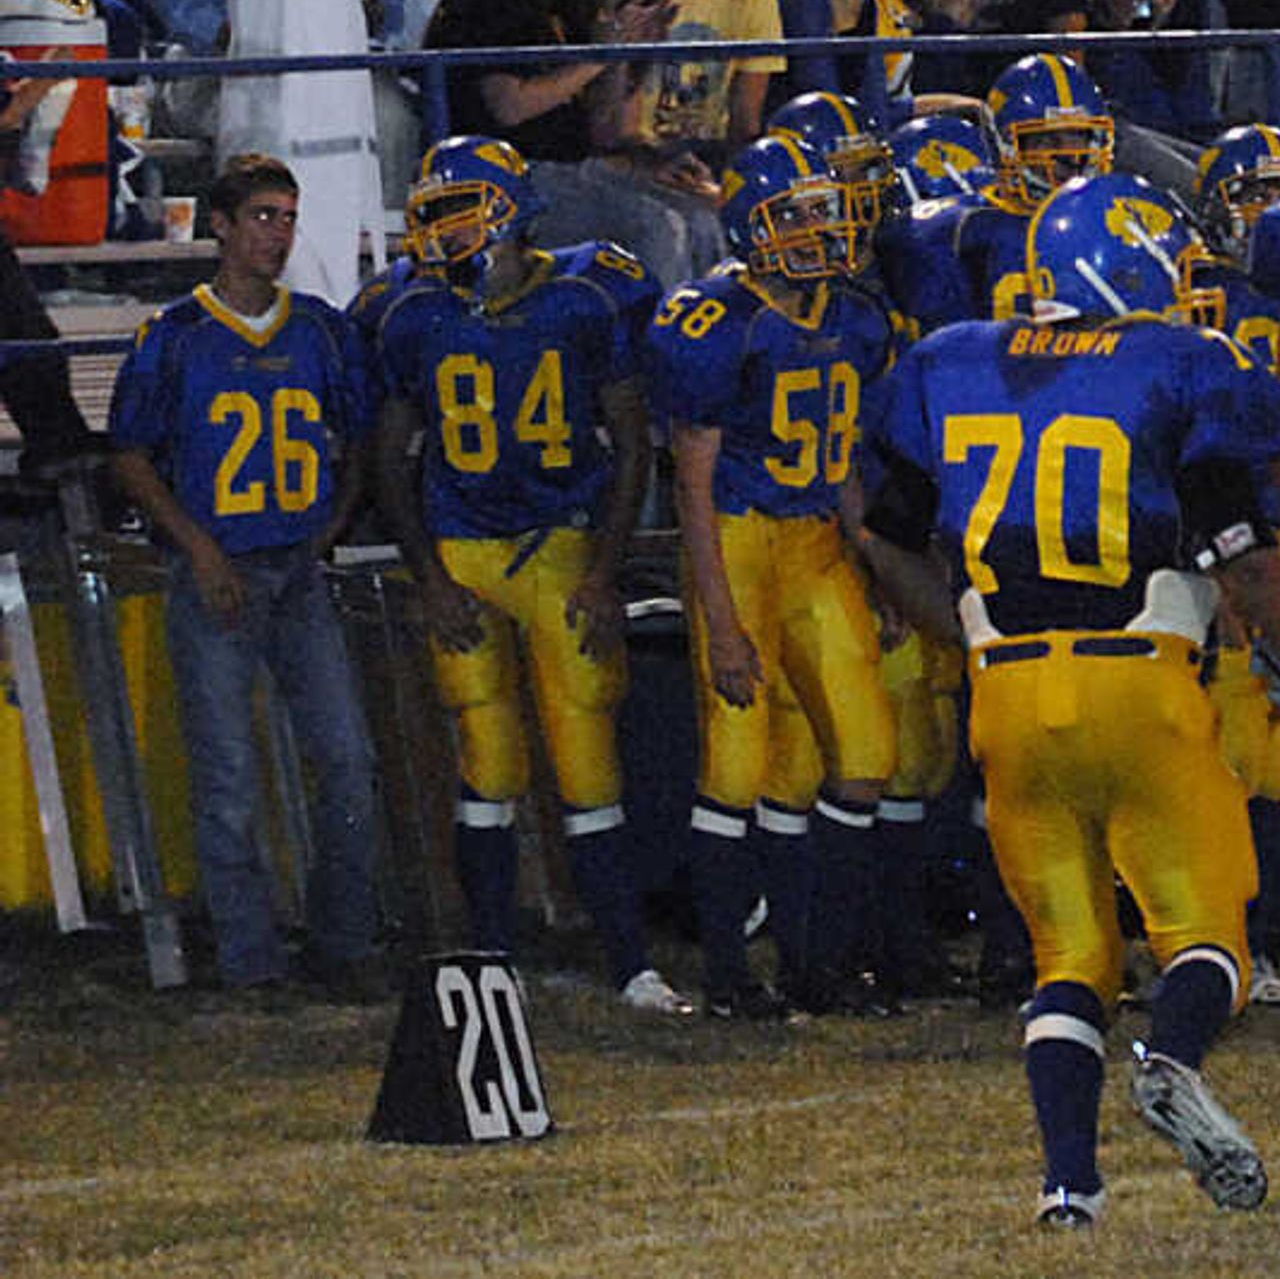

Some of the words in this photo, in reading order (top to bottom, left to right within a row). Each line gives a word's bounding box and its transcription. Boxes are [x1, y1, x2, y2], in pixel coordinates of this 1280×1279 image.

[652, 288, 727, 339] 58
[1007, 327, 1121, 355] BROWN
[208, 387, 323, 517] 26
[434, 350, 573, 474] 84
[764, 361, 860, 489] 58
[943, 413, 1132, 593] 70
[435, 966, 550, 1140] 20
